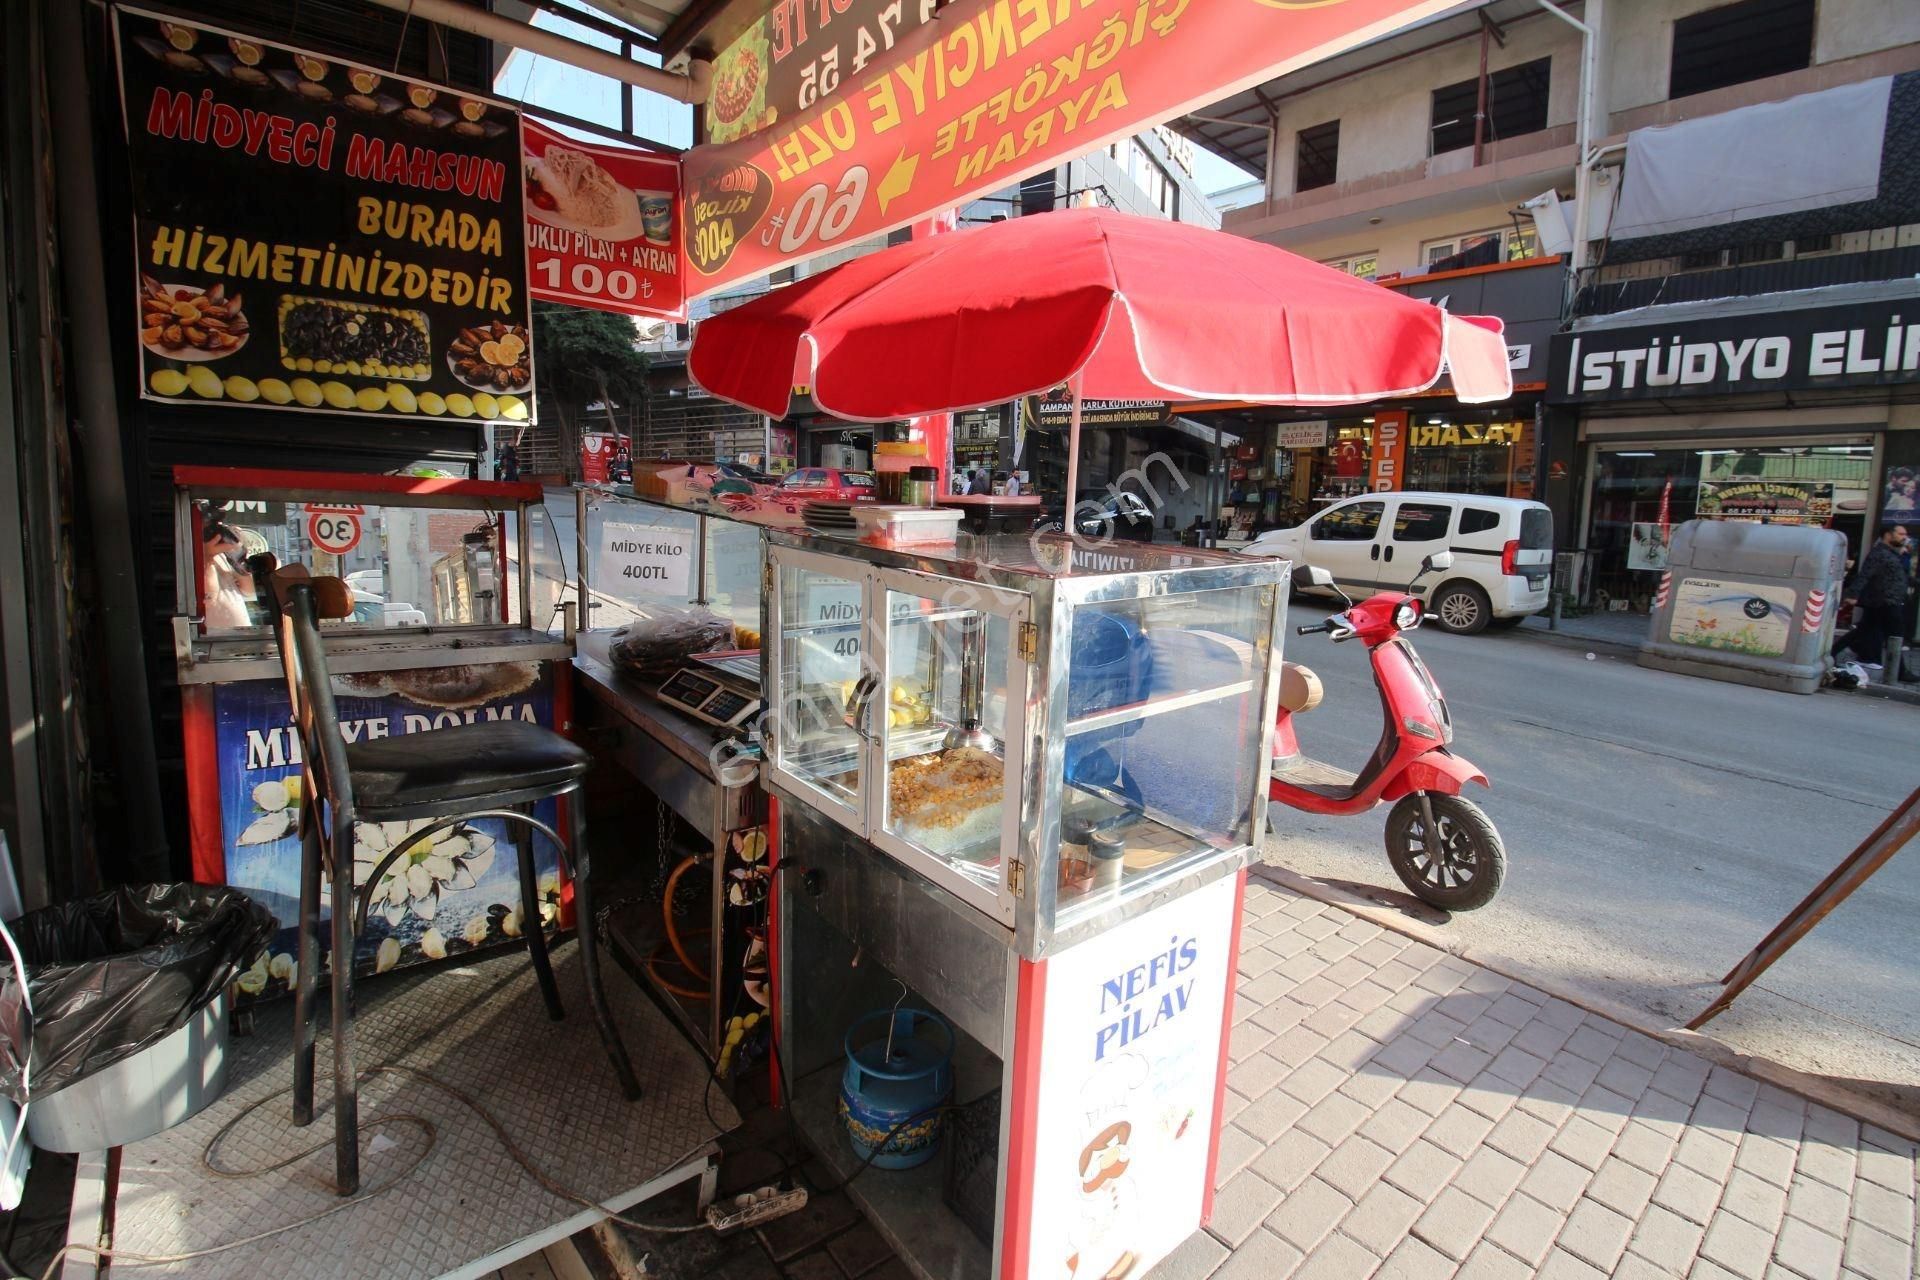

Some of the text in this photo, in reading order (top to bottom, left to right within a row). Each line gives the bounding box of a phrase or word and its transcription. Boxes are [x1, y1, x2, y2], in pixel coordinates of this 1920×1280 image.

[147, 86, 507, 203] MİDYECİ MAHSUN
[357, 196, 503, 257] BURADA
[574, 229, 616, 263] PİLAV
[632, 246, 677, 276] AYRAN
[151, 225, 513, 316] HİZMETİNİZDEDİR
[1582, 335, 1792, 392] STÜDYO
[1375, 421, 1399, 492] STEP
[610, 540, 683, 557] MİDYE KİLO
[622, 564, 669, 581] 400TL
[820, 601, 862, 621] MİDY
[246, 713, 391, 770] MİYE
[1099, 935, 1198, 1016] NEFİS
[1094, 978, 1196, 1063] PİLAV
